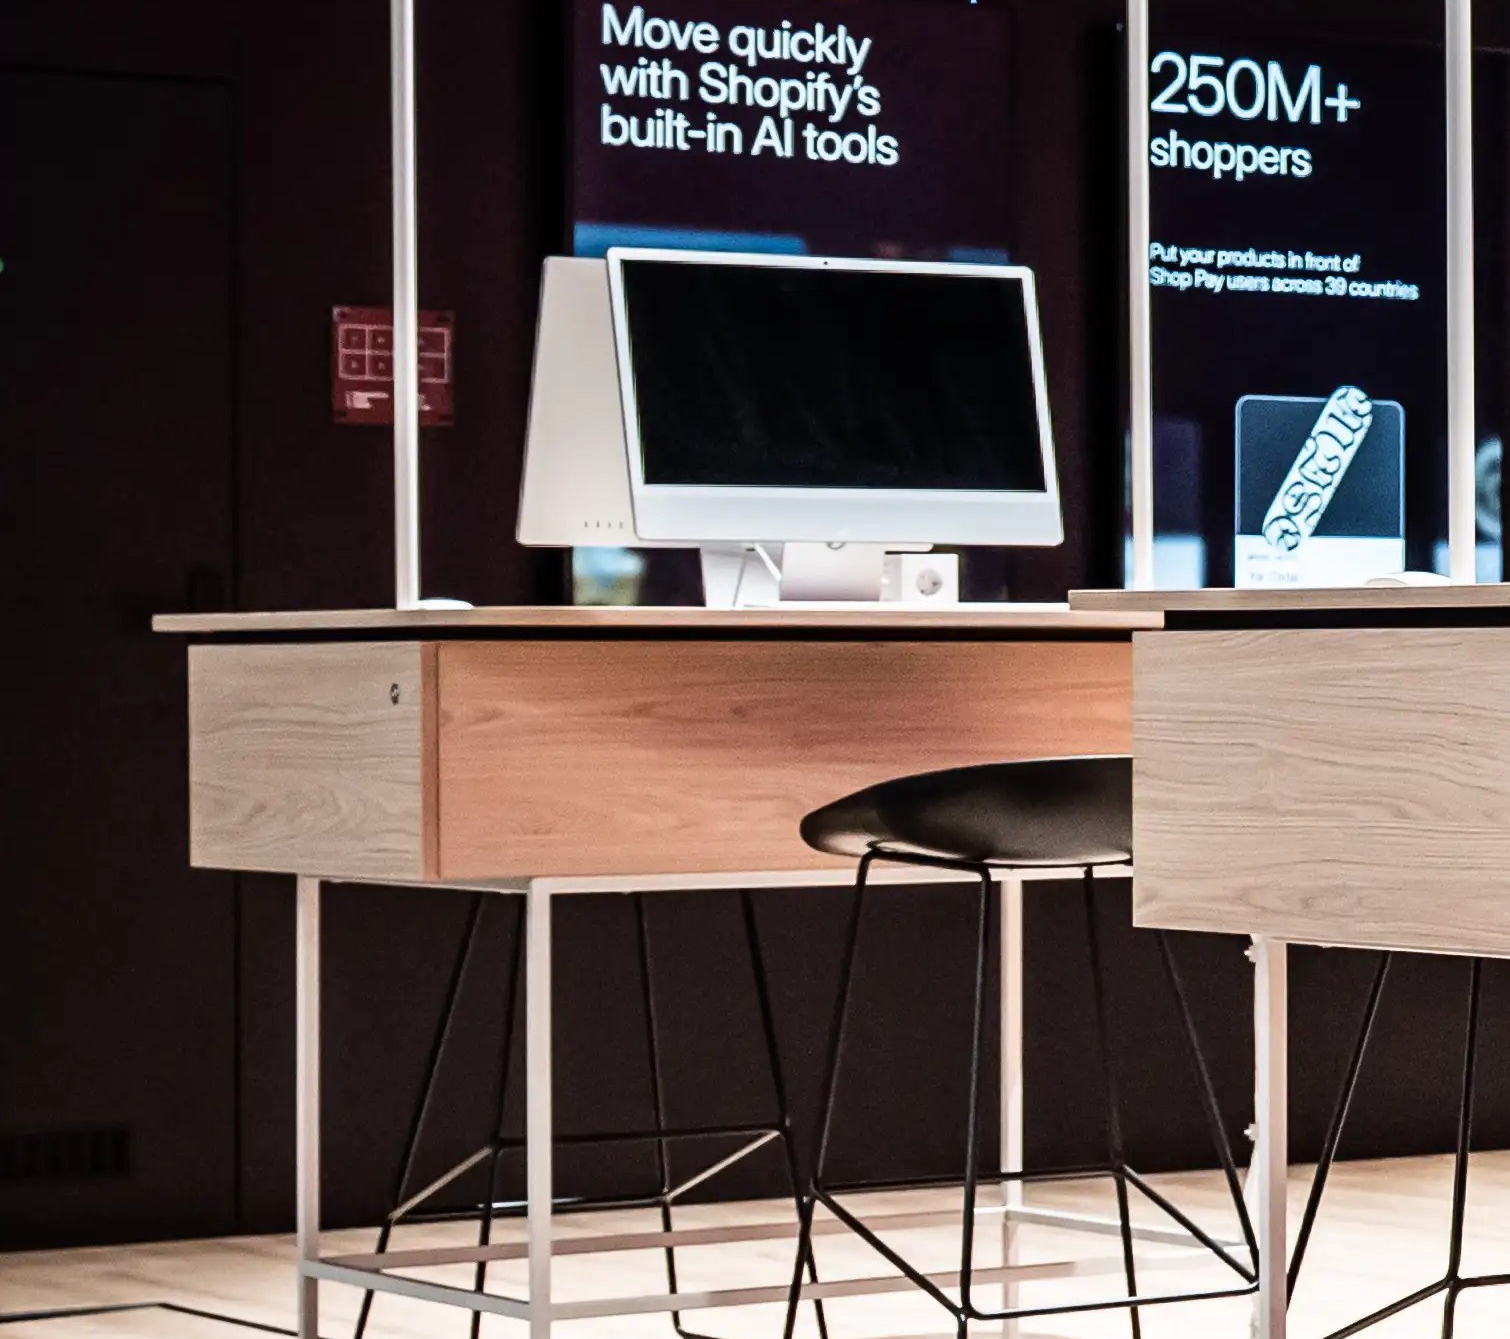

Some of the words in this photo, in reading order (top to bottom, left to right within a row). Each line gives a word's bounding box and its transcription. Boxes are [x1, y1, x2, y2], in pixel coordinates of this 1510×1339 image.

[601, 3, 720, 54] Move
[728, 20, 872, 76] quickly
[600, 57, 689, 100] with
[699, 61, 882, 123] Shopify's
[1150, 51, 1361, 125] 250M+
[600, 103, 742, 155] built-in
[750, 115, 795, 158] AI
[802, 122, 900, 166] tools
[1150, 129, 1313, 181] shoppers
[1149, 266, 1193, 290] Shop
[1194, 268, 1225, 293] Pay
[1226, 274, 1270, 292] users
[1272, 278, 1323, 295] across
[1325, 276, 1347, 296] 39
[1349, 280, 1419, 300] countries
[1150, 242, 1178, 262] Put
[1180, 248, 1216, 267] your
[1217, 248, 1286, 269] products
[1288, 250, 1304, 269] in
[1305, 251, 1341, 272] front
[1342, 253, 1361, 273] of
